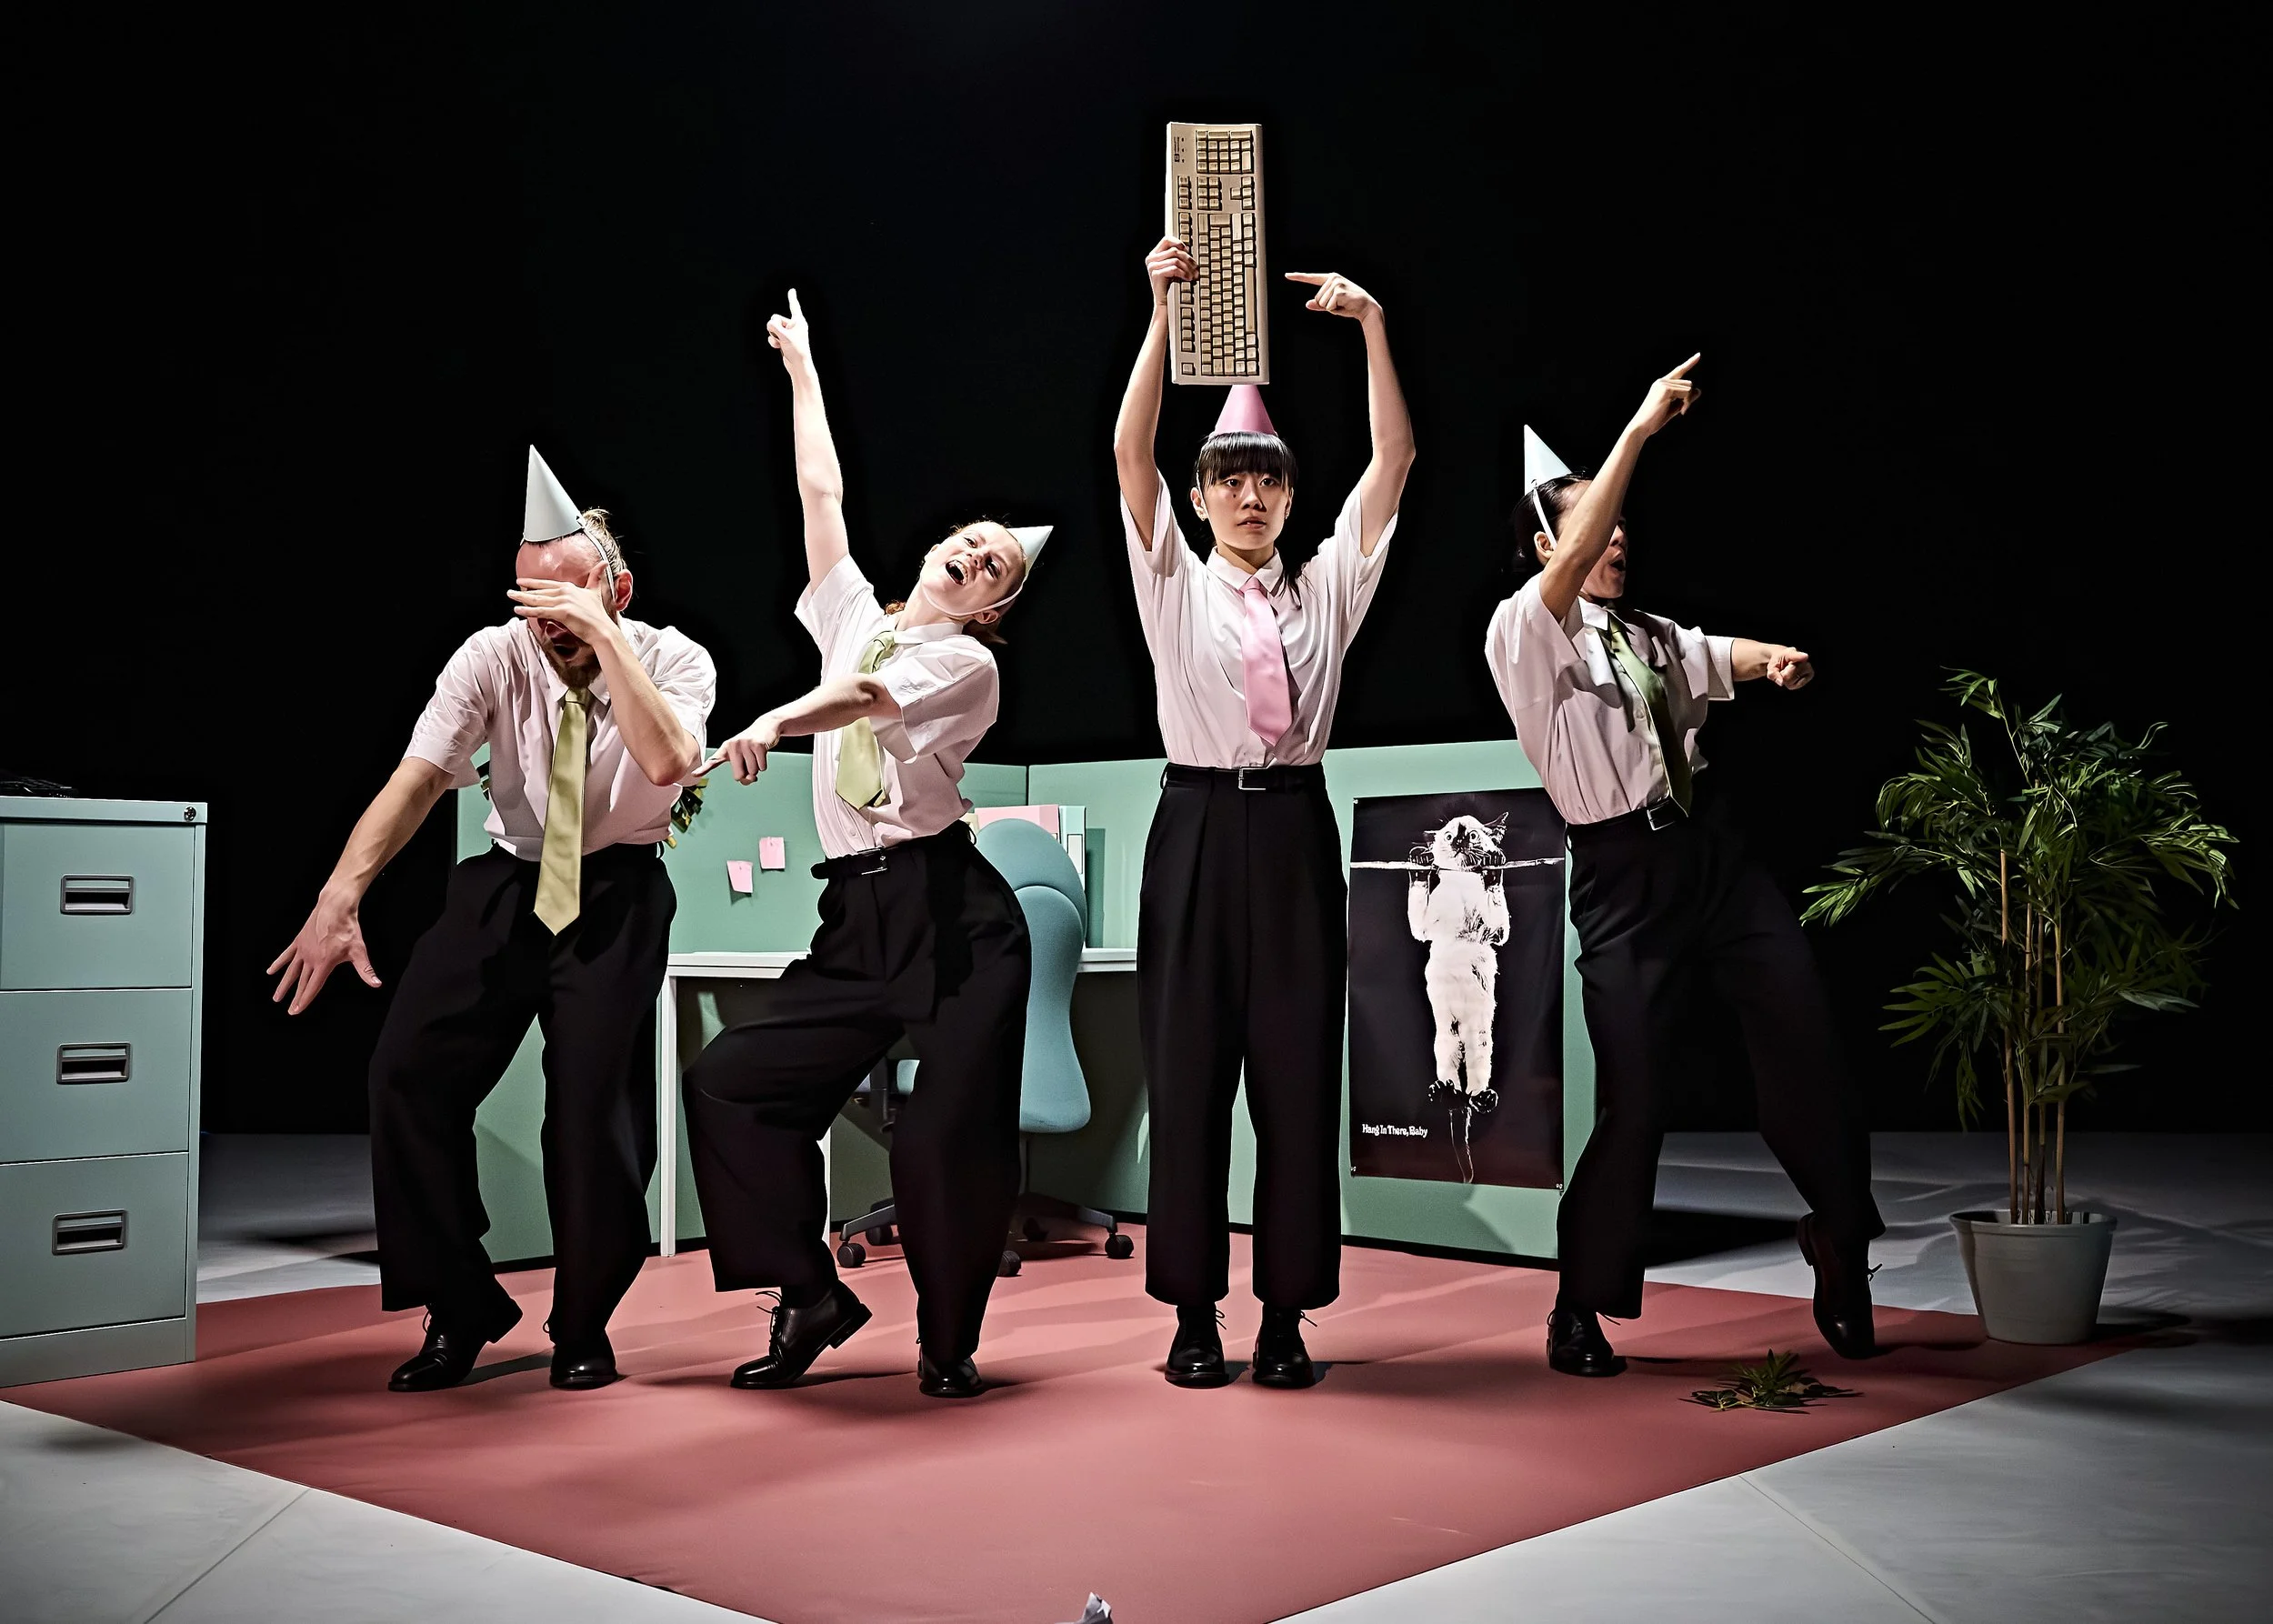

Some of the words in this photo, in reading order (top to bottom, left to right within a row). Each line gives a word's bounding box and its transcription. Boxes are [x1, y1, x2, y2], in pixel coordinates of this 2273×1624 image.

[1362, 1124, 1380, 1137] Hang
[1380, 1125, 1387, 1134] In
[1387, 1125, 1408, 1137] There,
[1408, 1126, 1427, 1138] Baby
